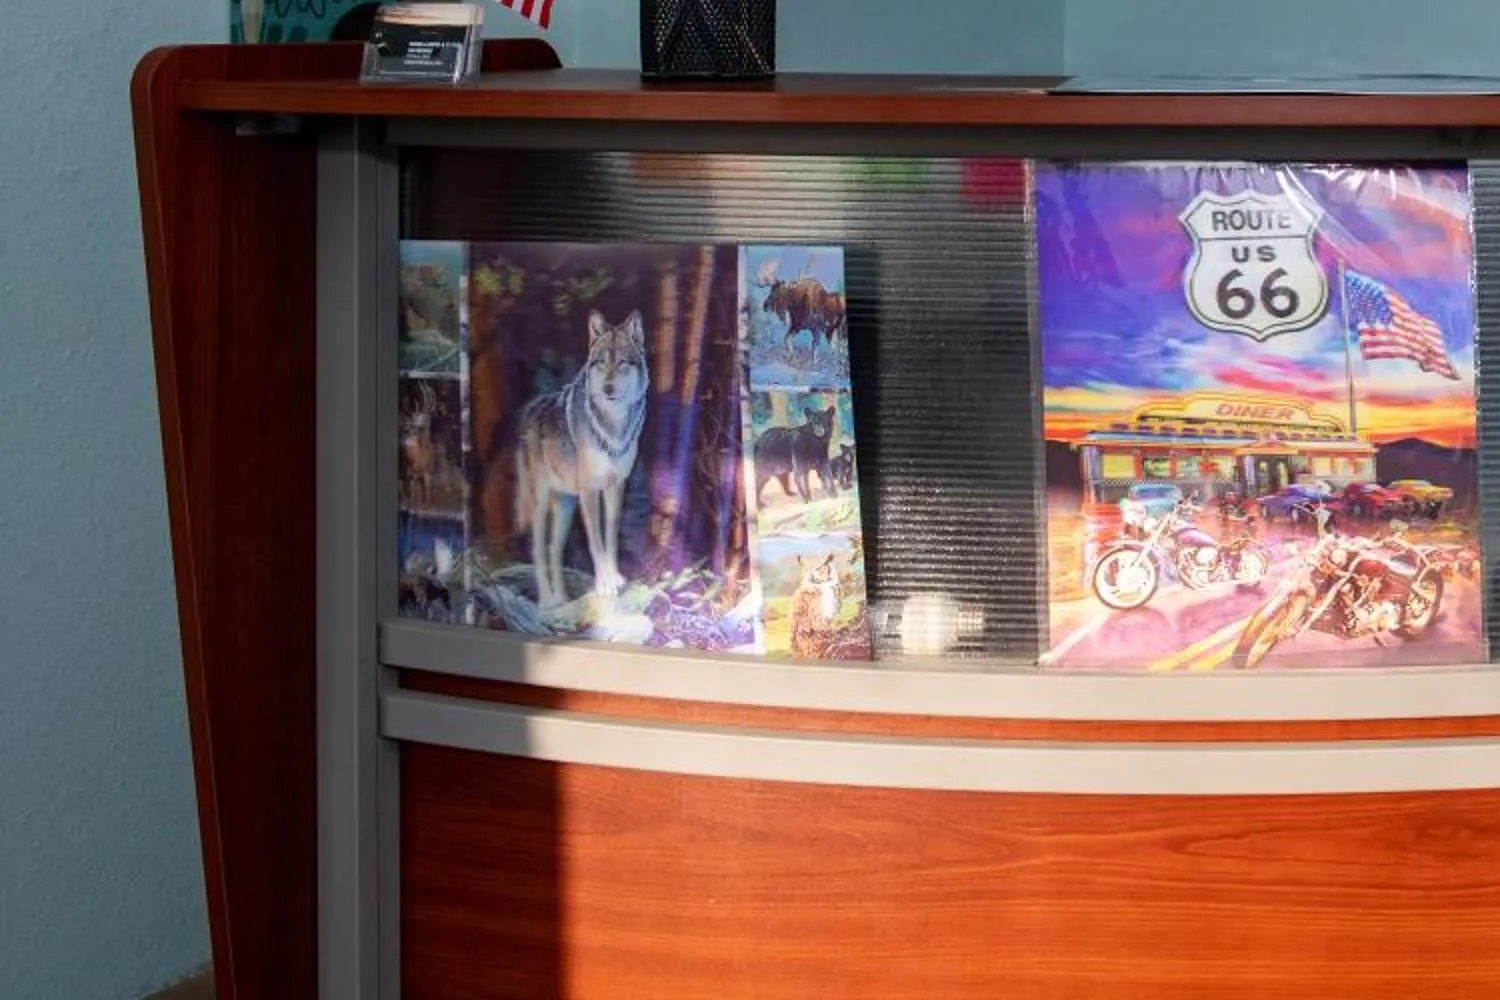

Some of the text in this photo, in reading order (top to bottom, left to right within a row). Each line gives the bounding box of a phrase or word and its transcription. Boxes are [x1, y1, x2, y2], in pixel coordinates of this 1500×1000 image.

[1211, 208, 1291, 232] ROUTE
[1231, 244, 1278, 263] US
[1216, 267, 1300, 319] 66
[1215, 403, 1294, 420] DINER
